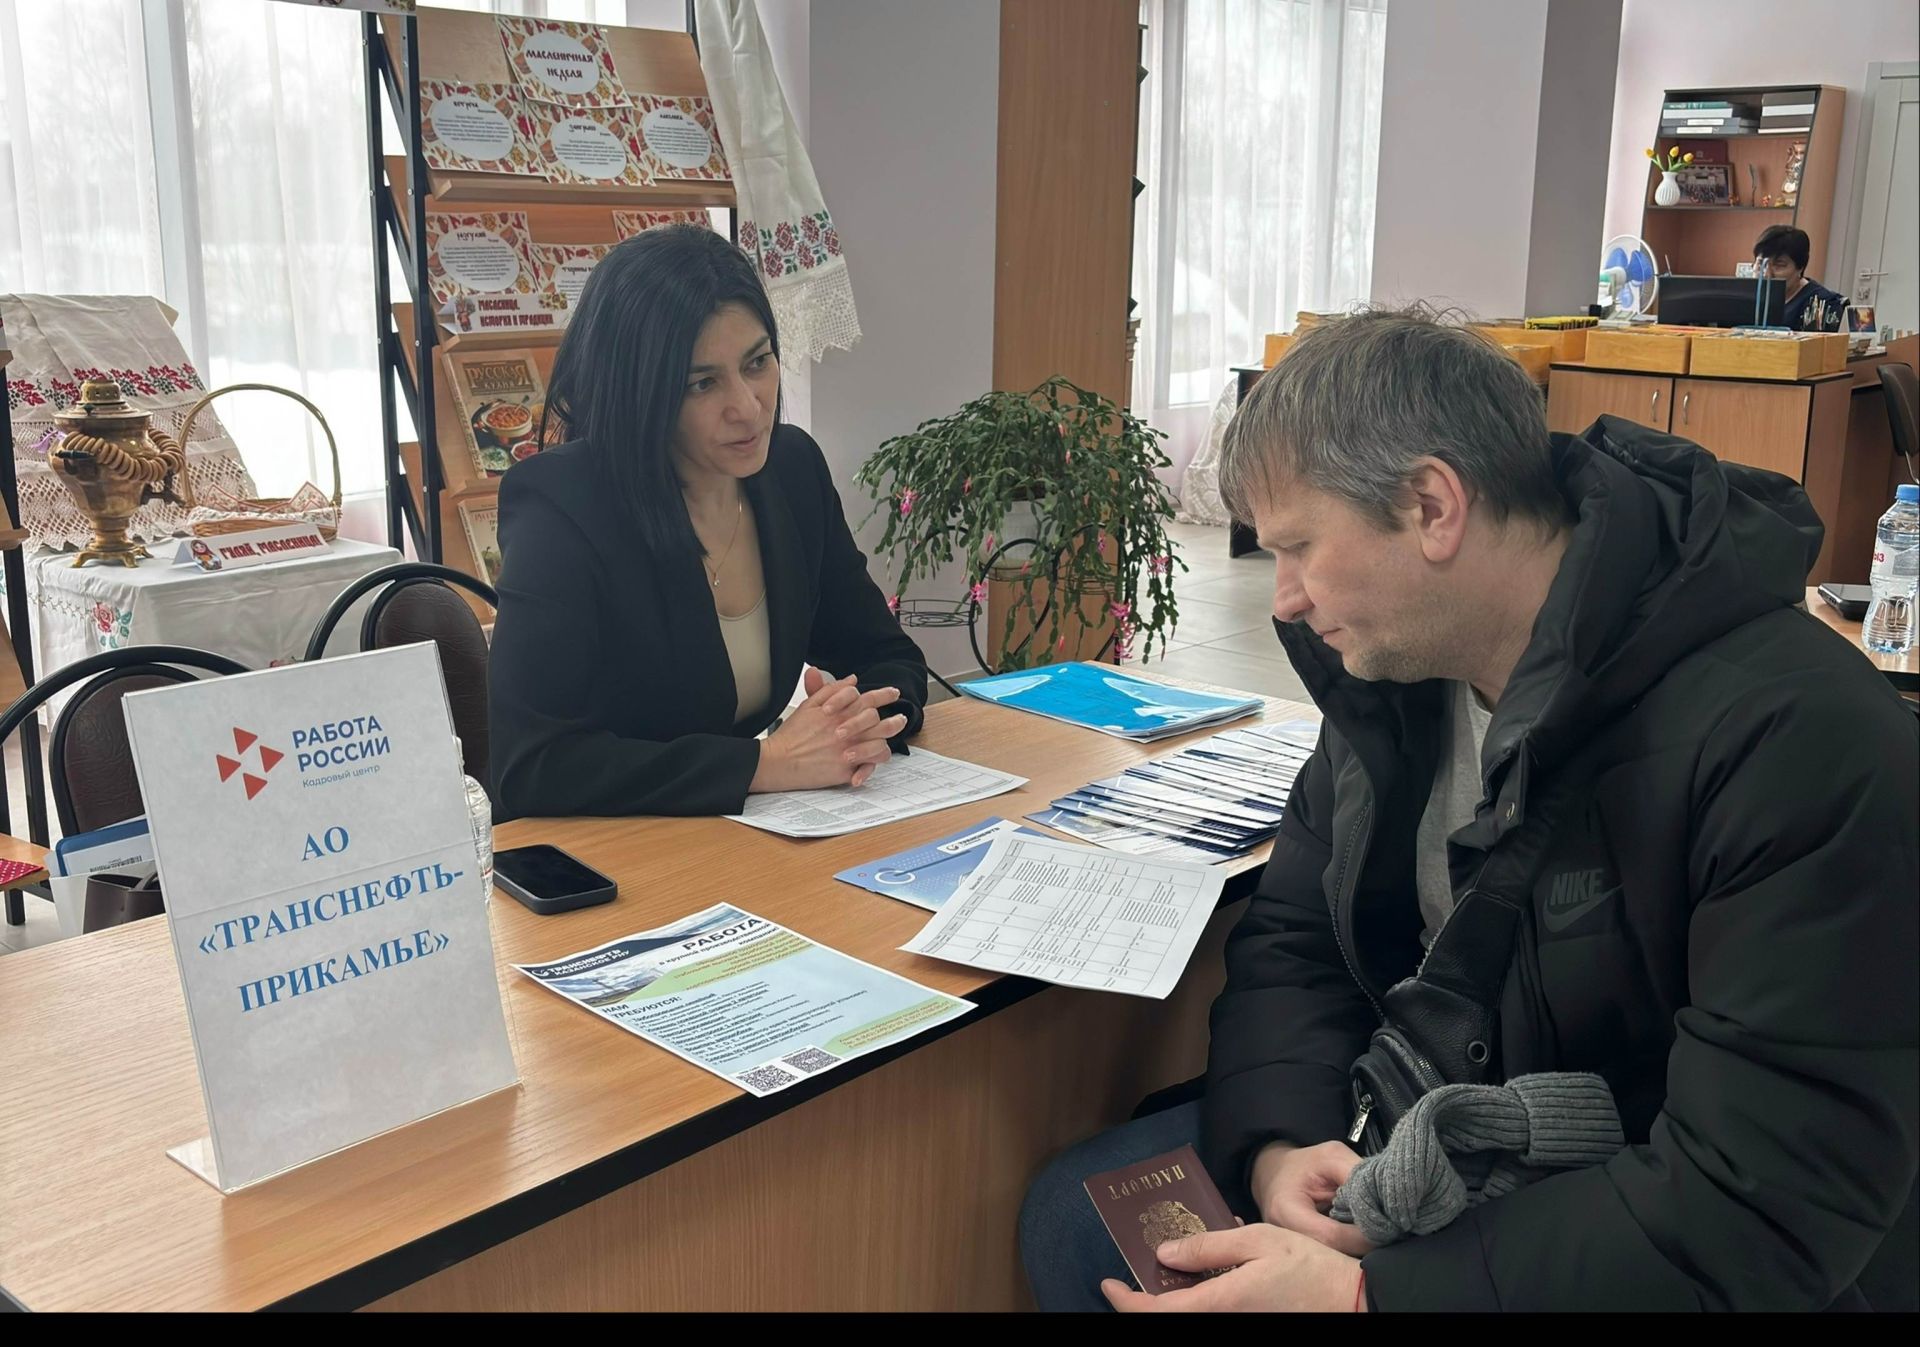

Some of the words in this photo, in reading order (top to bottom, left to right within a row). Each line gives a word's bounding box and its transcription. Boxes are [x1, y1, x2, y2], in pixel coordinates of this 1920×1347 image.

[526, 49, 594, 63] МАСЛЕНИЧНАЯ
[547, 67, 583, 82] НЕДЕЛЯ
[480, 315, 512, 327] ИСТОРИЯ
[292, 715, 382, 749] РАБОТА
[297, 736, 391, 772] РОССИИ
[302, 770, 351, 788] Кадровый
[352, 764, 380, 777] центр
[301, 826, 349, 861] АО
[1550, 868, 1603, 906] NIKE
[199, 862, 464, 954] «ТРАНСНЕФТЬ-
[682, 918, 762, 950] РАБОТА
[237, 929, 450, 1012] ПРИКАМЬЕ»
[602, 1004, 629, 1014] НАМ
[610, 996, 683, 1020] ТРЕБУЮТСЯ:
[1108, 1164, 1186, 1200] ПАСПОРТ
